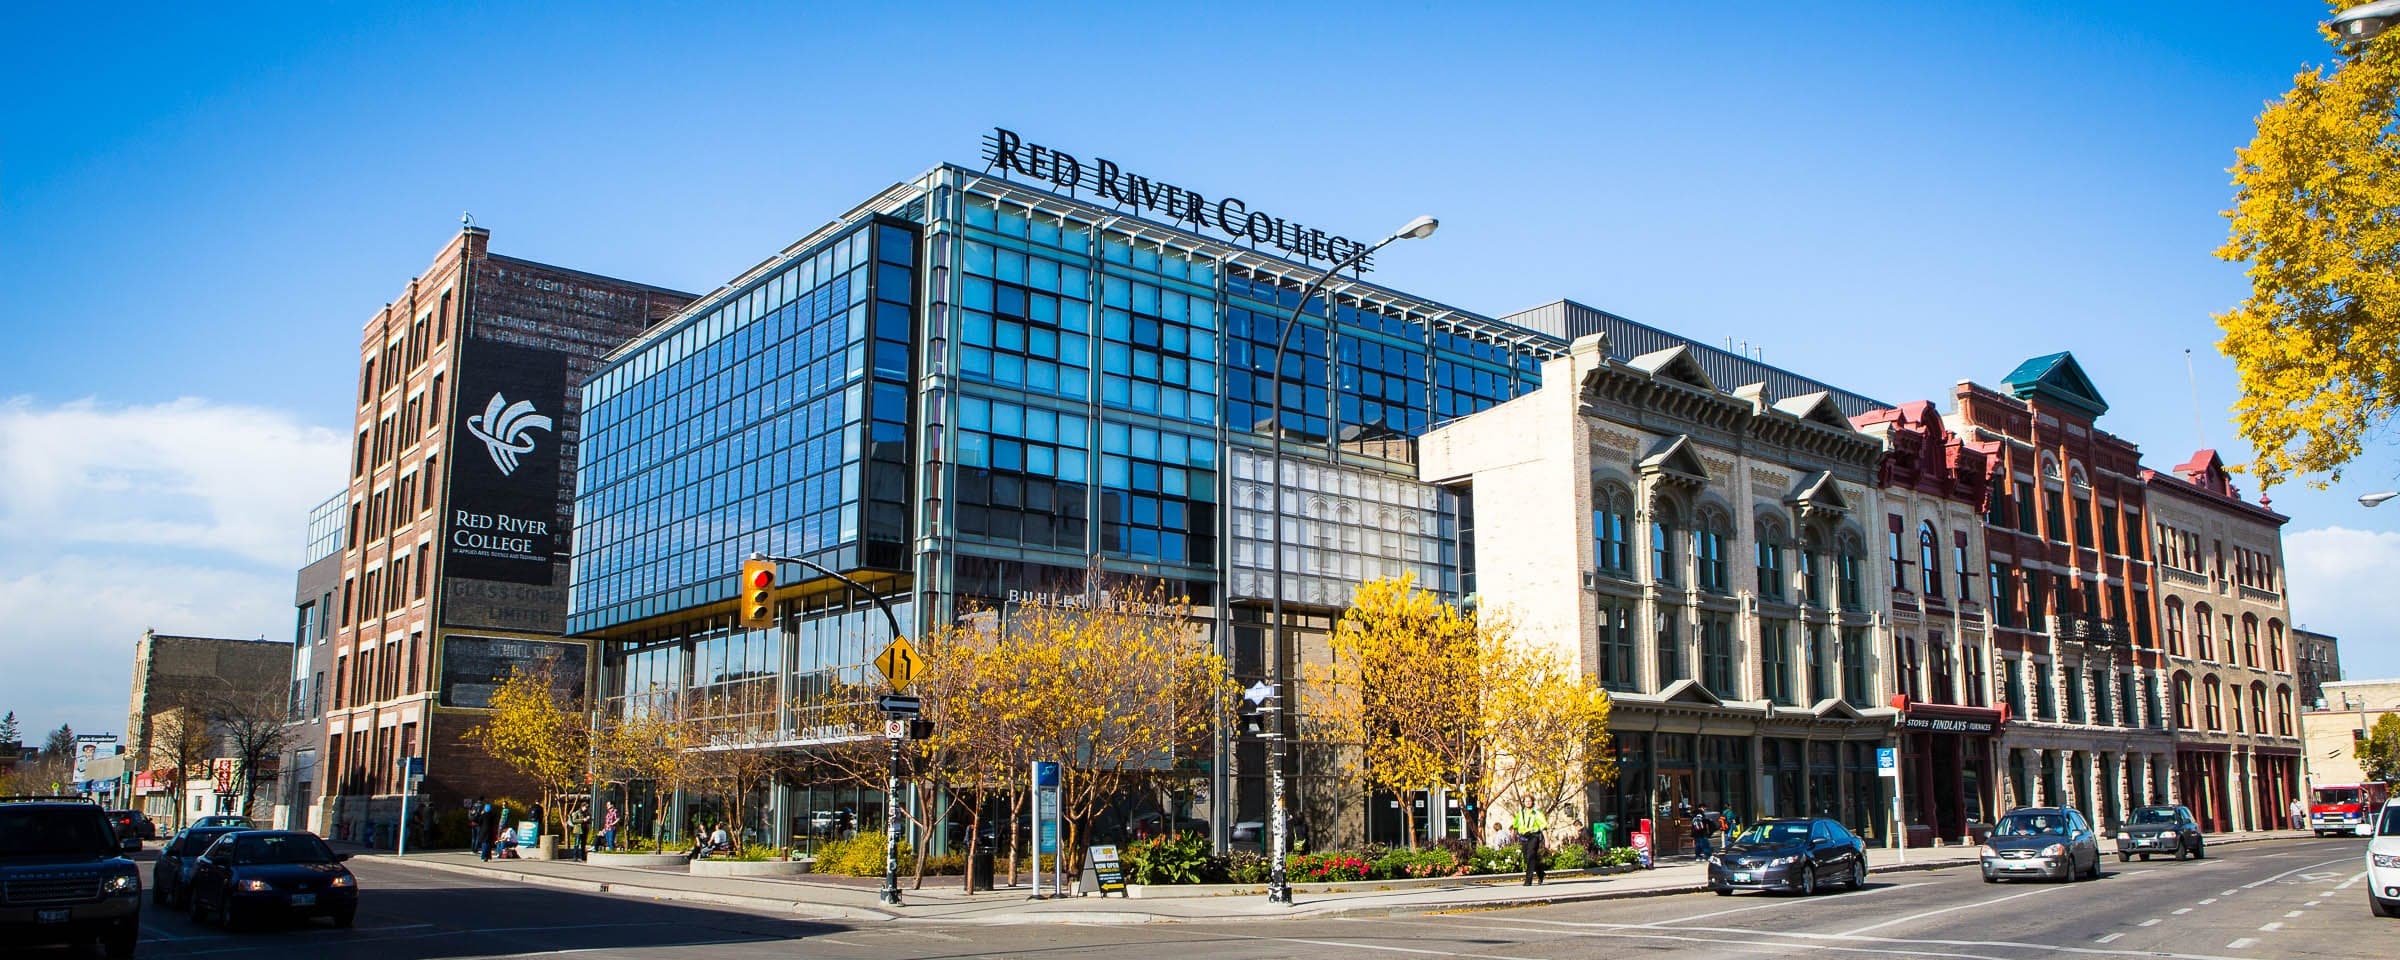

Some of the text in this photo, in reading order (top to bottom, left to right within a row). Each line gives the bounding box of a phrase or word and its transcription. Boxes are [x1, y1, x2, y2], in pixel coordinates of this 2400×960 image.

[994, 127, 1367, 273] RED RIVER COLLEGE
[455, 509, 549, 535] RED RIVER
[454, 530, 532, 553] COLLEGE
[1906, 719, 1929, 728] STOVES
[1931, 719, 1968, 731] FINDLAYS
